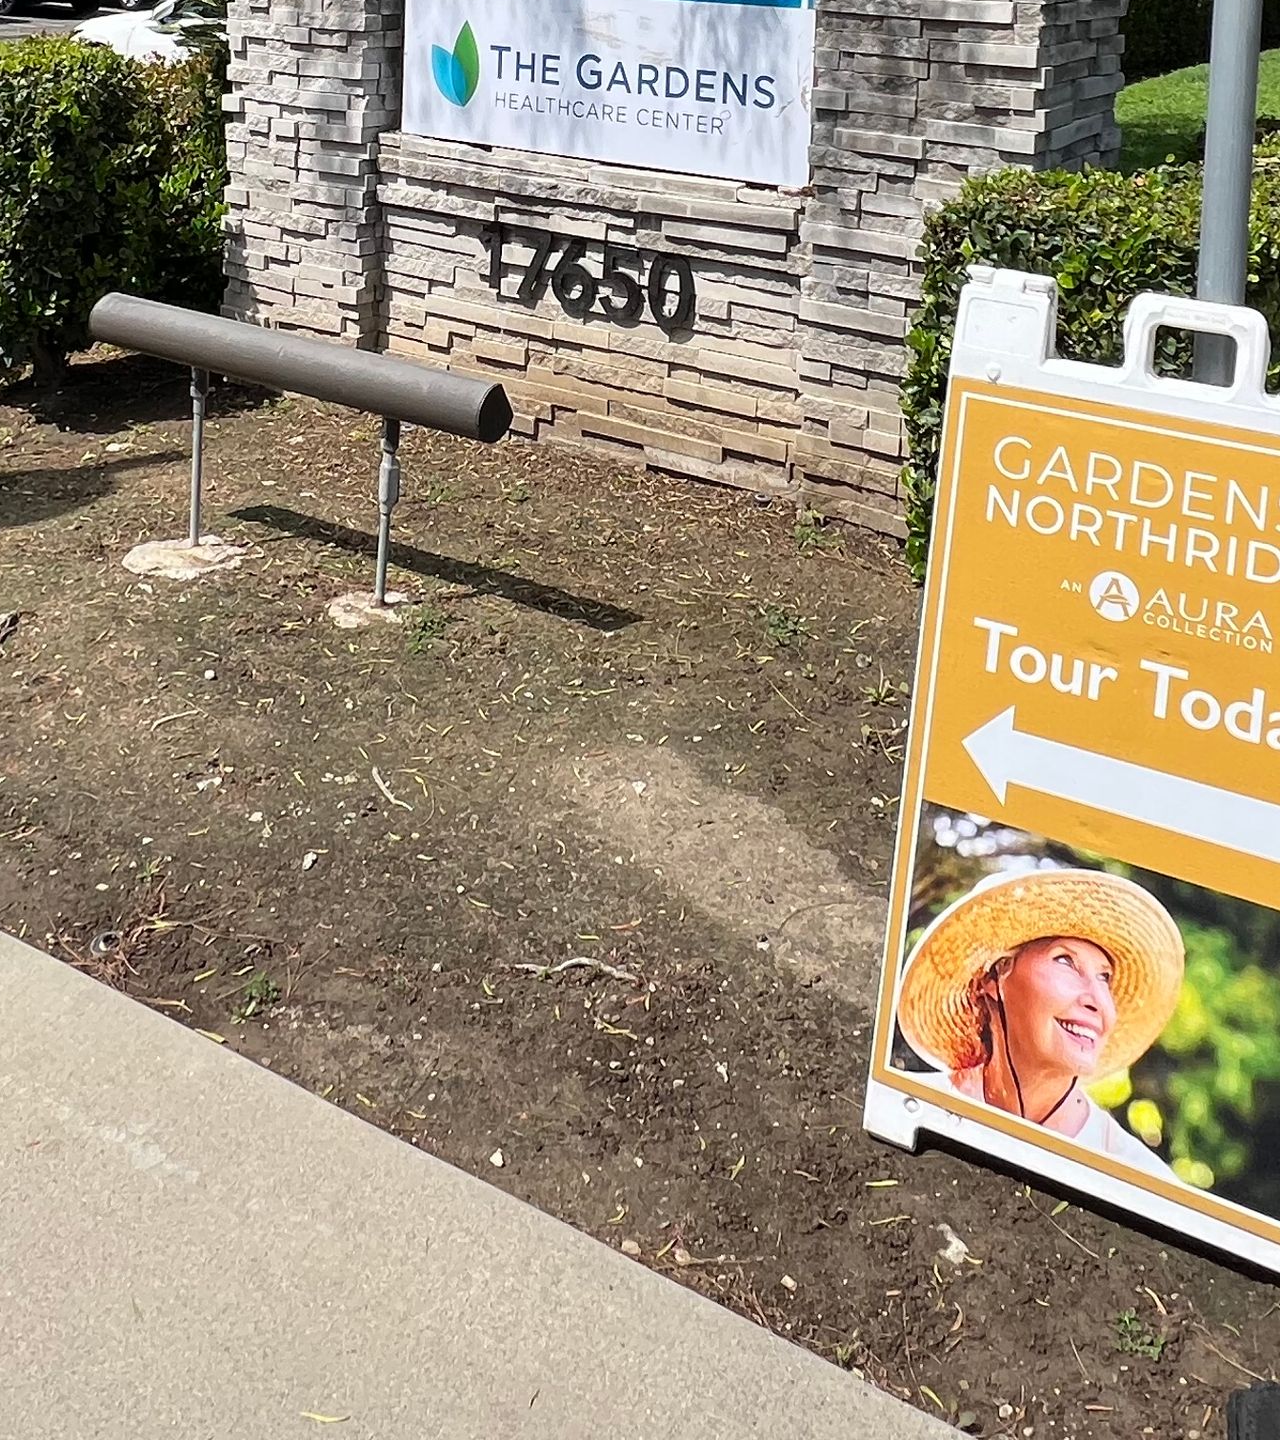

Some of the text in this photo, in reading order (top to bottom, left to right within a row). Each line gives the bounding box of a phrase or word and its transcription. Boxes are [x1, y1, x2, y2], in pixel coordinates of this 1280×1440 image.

[490, 44, 776, 110] THE GARDENS
[494, 91, 725, 136] HEALTHCARE CENTER
[479, 224, 695, 336] 17650
[1060, 578, 1083, 594] AN
[1144, 587, 1273, 640] AURA
[1142, 611, 1273, 654] COLLECTION
[972, 617, 1118, 701] Tour
